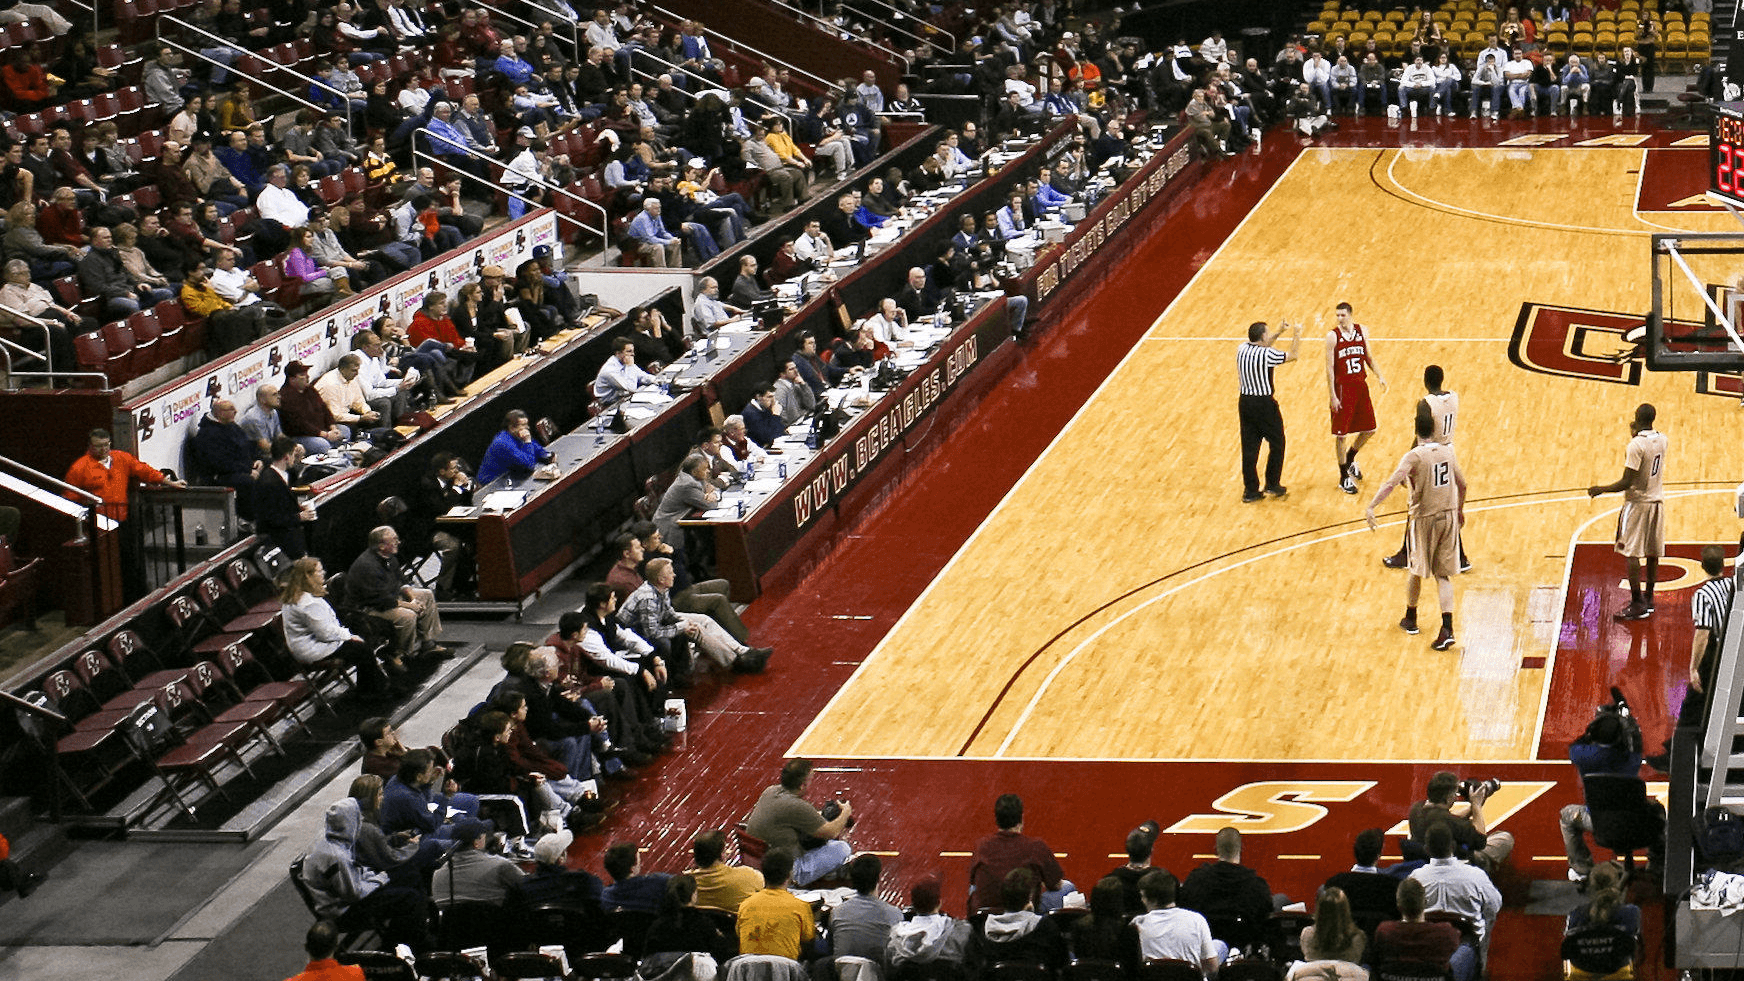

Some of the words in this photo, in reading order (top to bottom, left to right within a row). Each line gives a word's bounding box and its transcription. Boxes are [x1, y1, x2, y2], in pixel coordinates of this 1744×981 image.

[1036, 262, 1059, 302] FOR
[1345, 358, 1362, 375] 15
[794, 334, 978, 529] WWW.BCEAGLES.COM
[1443, 413, 1452, 436] 11
[1434, 462, 1449, 487] 12
[1651, 454, 1661, 477] 0
